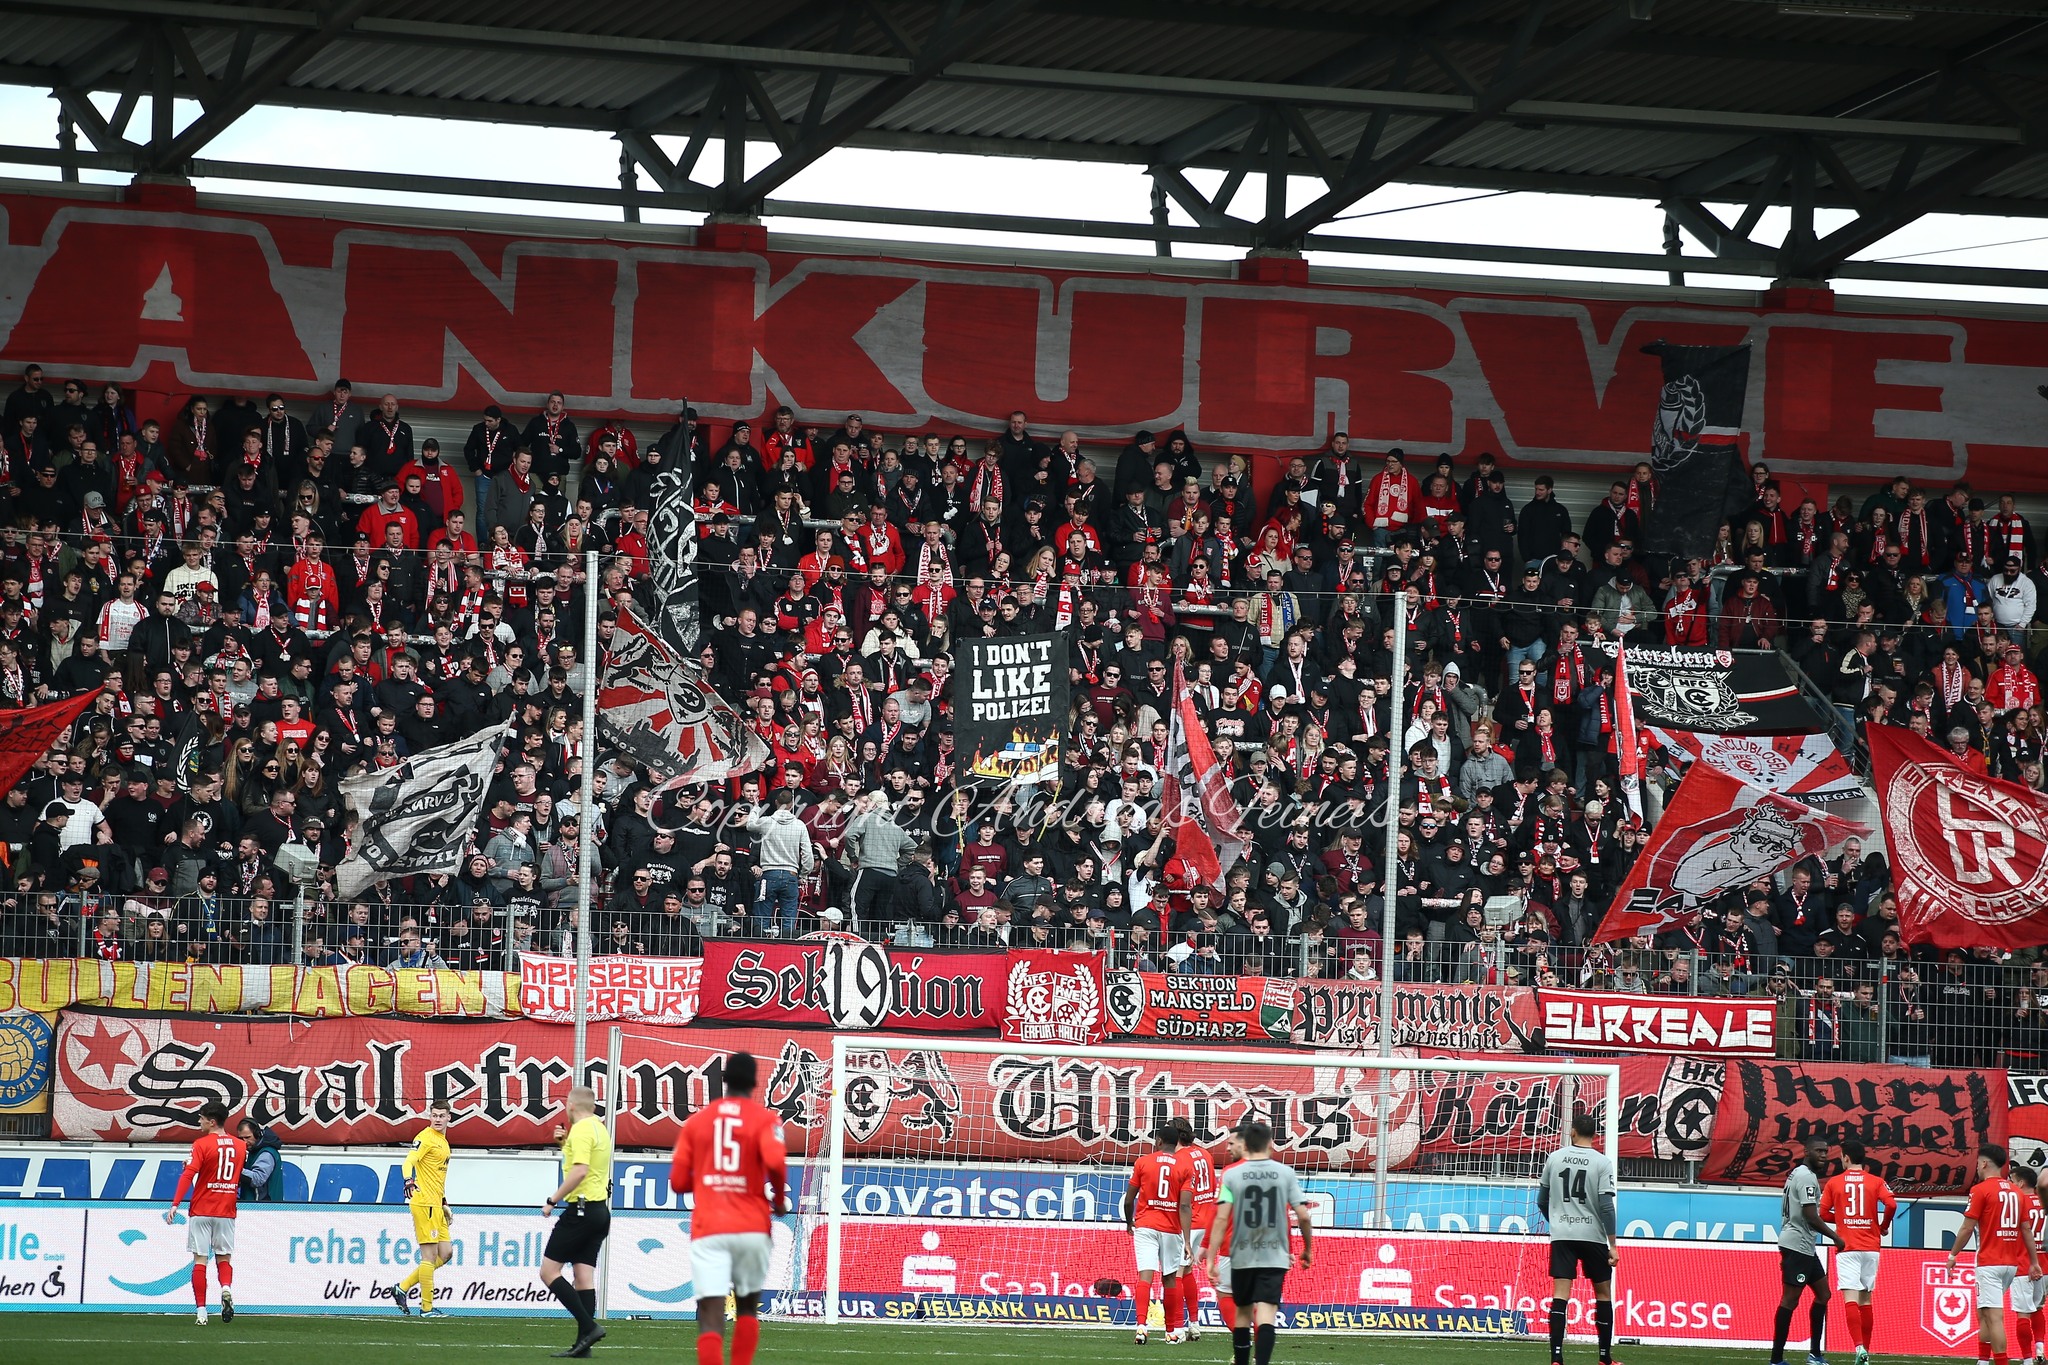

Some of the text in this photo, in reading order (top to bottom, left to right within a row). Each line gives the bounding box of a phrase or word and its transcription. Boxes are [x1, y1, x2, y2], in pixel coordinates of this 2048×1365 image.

[972, 640, 1052, 667] I DON'T
[971, 664, 1052, 700] LIKE
[1677, 679, 1708, 688] HFC
[971, 695, 1051, 721] POLIZEI
[1806, 788, 1865, 804] SIEGEN
[258, 963, 485, 1016] JAGEN
[1023, 974, 1047, 985] HFC
[1059, 979, 1076, 990] FC
[1167, 975, 1237, 991] SEKTION
[1150, 990, 1257, 1011] MANSFELD
[1294, 985, 1503, 1042] Pyrmanie
[1155, 1012, 1247, 1039] SÜDHARZ
[1545, 1001, 1774, 1049] SURREALE
[845, 1053, 884, 1070] HFC
[712, 1117, 741, 1172] 15
[216, 1147, 236, 1181] 16
[1562, 1156, 1589, 1166] AKONO
[1157, 1165, 1170, 1199] 6
[1193, 1158, 1210, 1192] 33
[1242, 1170, 1279, 1180] BOLAND
[1558, 1167, 1587, 1205] 14
[1244, 1184, 1278, 1229] 31
[1845, 1183, 1864, 1217] 31
[1998, 1191, 2019, 1228] 20
[288, 1228, 365, 1264] reha
[1926, 1267, 1976, 1287] HFC
[323, 1280, 361, 1301] Wir
[462, 1283, 558, 1303] Menschen
[1034, 1302, 1113, 1322] HALLE
[1295, 1311, 1427, 1332] SPIELBANK
[1436, 1314, 1517, 1334] HALLE
